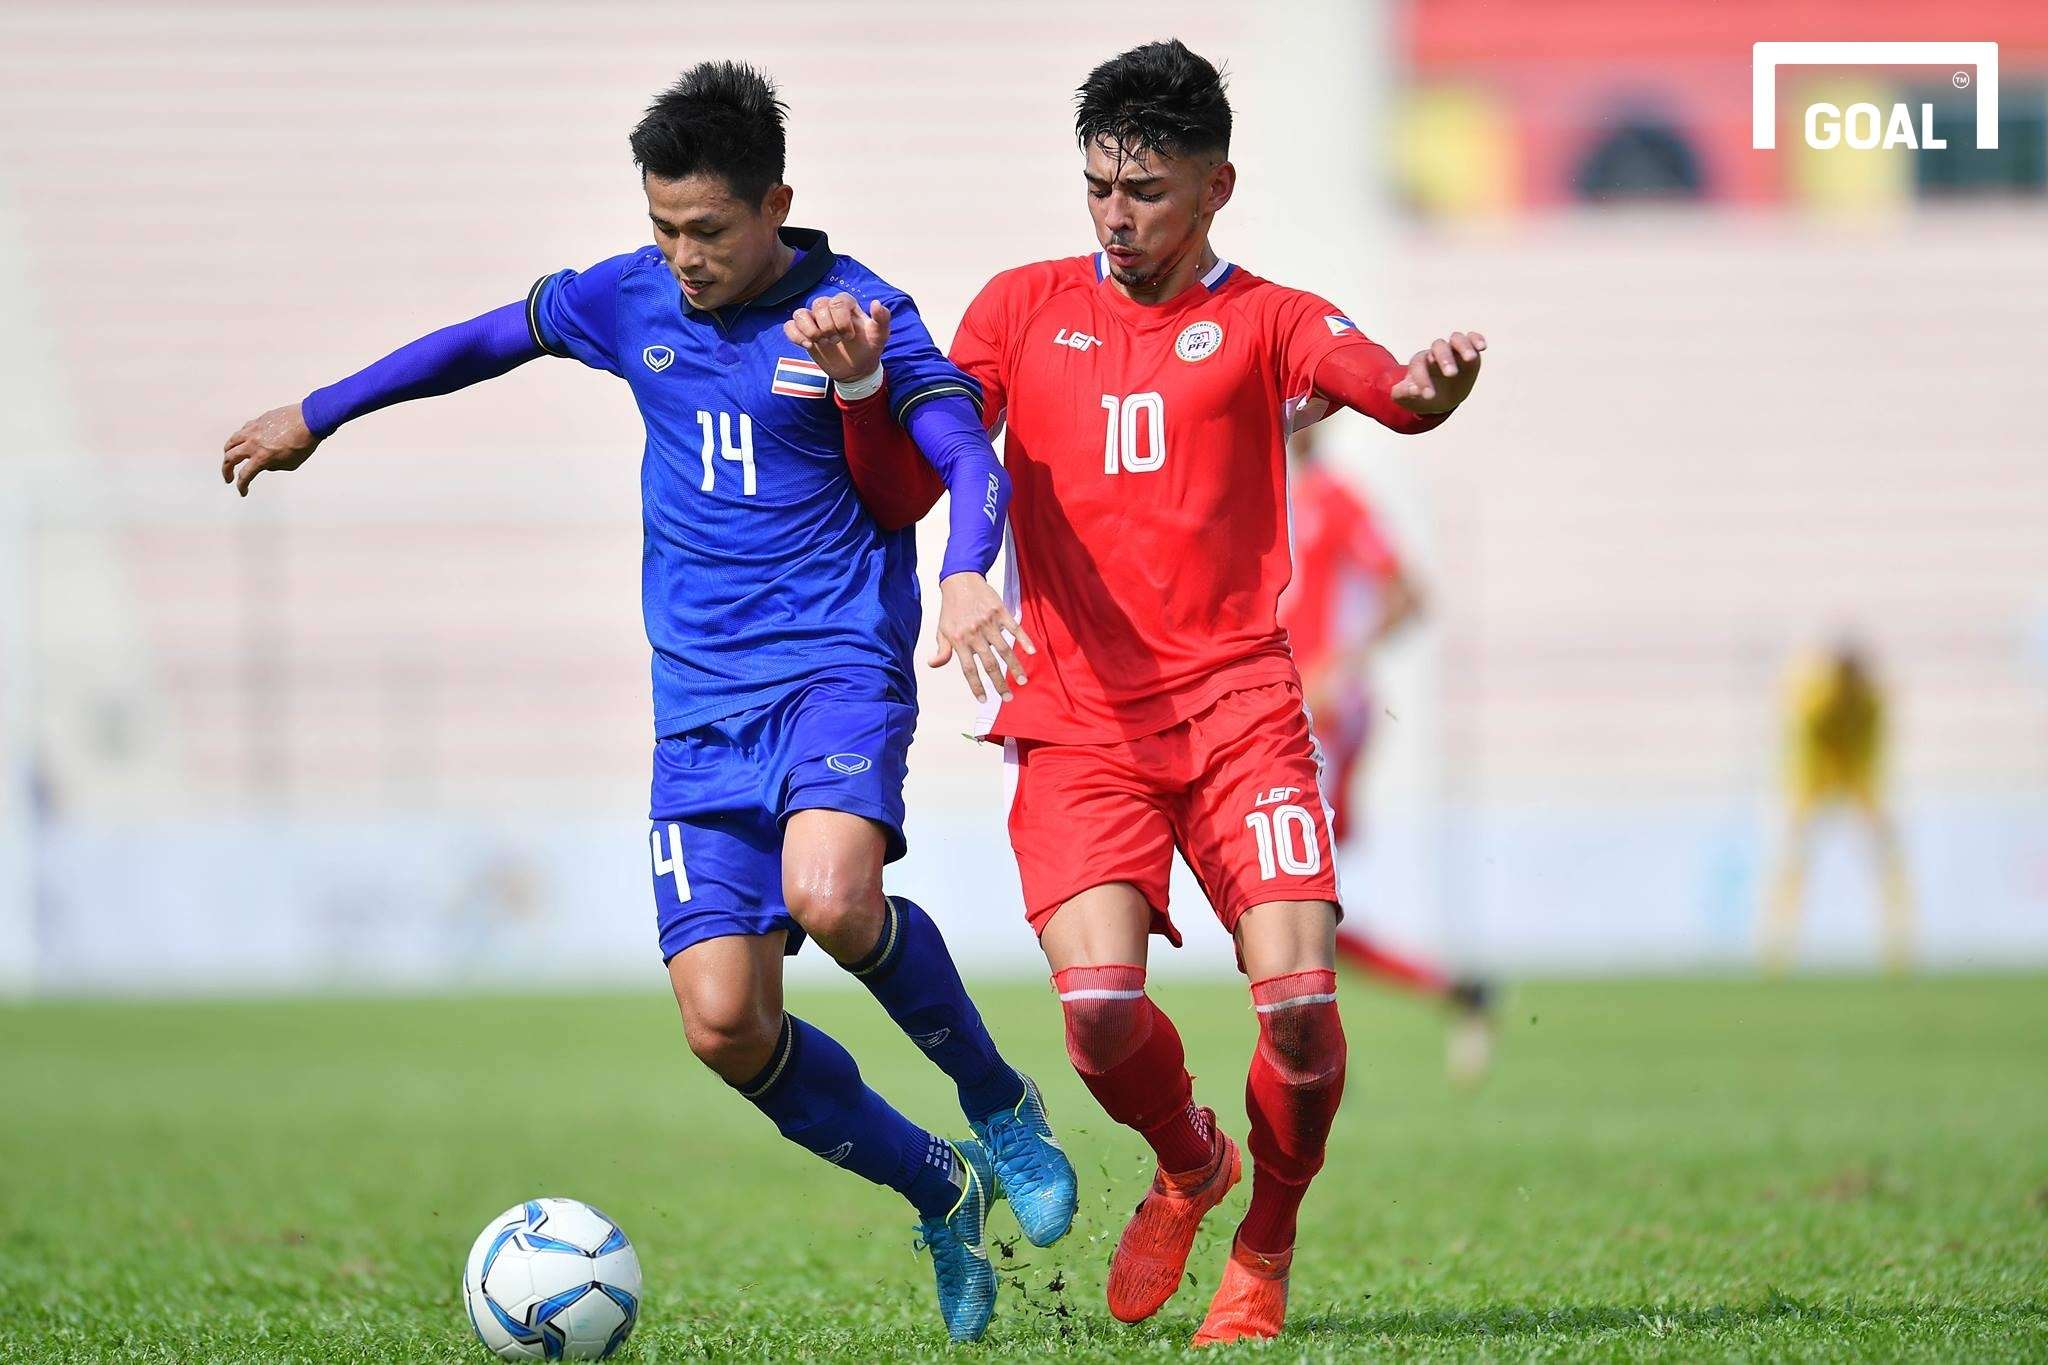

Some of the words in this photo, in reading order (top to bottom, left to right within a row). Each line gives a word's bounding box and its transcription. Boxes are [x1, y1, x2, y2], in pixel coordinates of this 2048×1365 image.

[1188, 341, 1210, 352] PFF
[696, 410, 757, 496] 14
[1100, 391, 1167, 475] 10
[1245, 804, 1321, 881] 10
